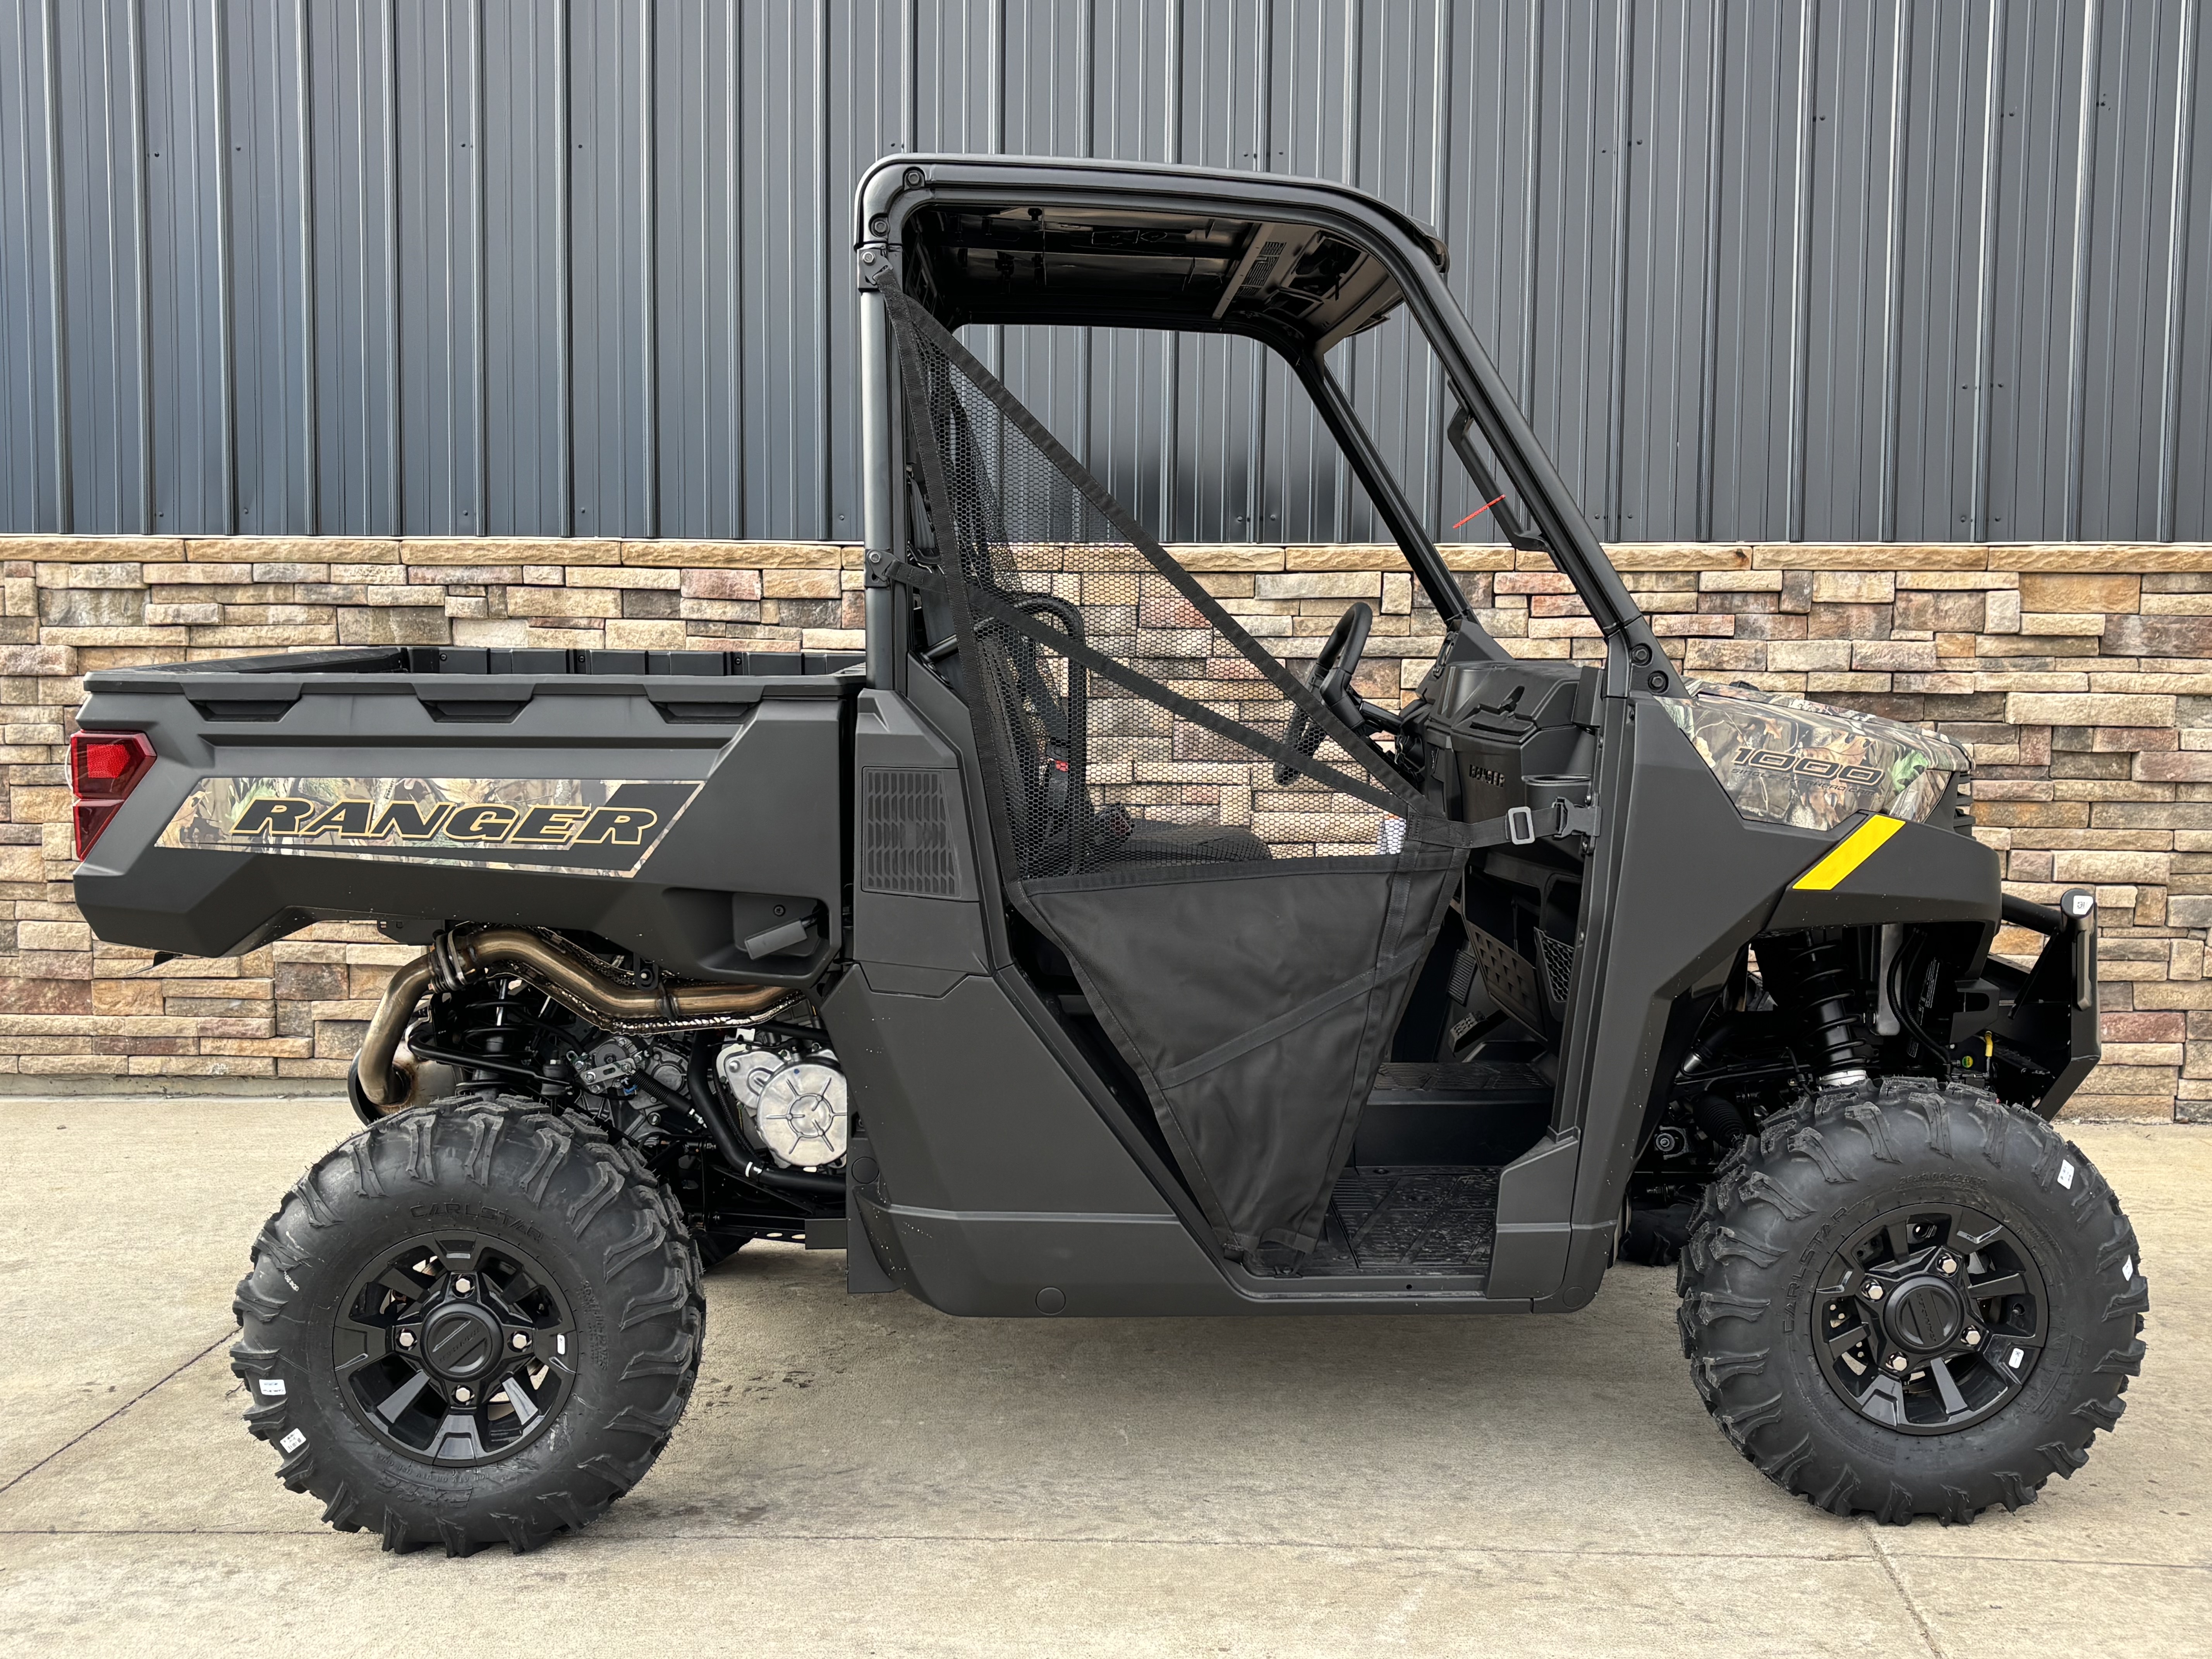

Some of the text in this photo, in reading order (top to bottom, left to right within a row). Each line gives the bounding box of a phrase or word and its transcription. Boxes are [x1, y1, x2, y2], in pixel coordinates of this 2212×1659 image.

[1731, 746, 1886, 788] 1000
[1731, 768, 1875, 796] SINGLE OVERHEAD CAM
[231, 797, 658, 846] RANGER
[409, 1202, 544, 1243] CARLSTAR
[1782, 1206, 1848, 1334] CARLSTAR
